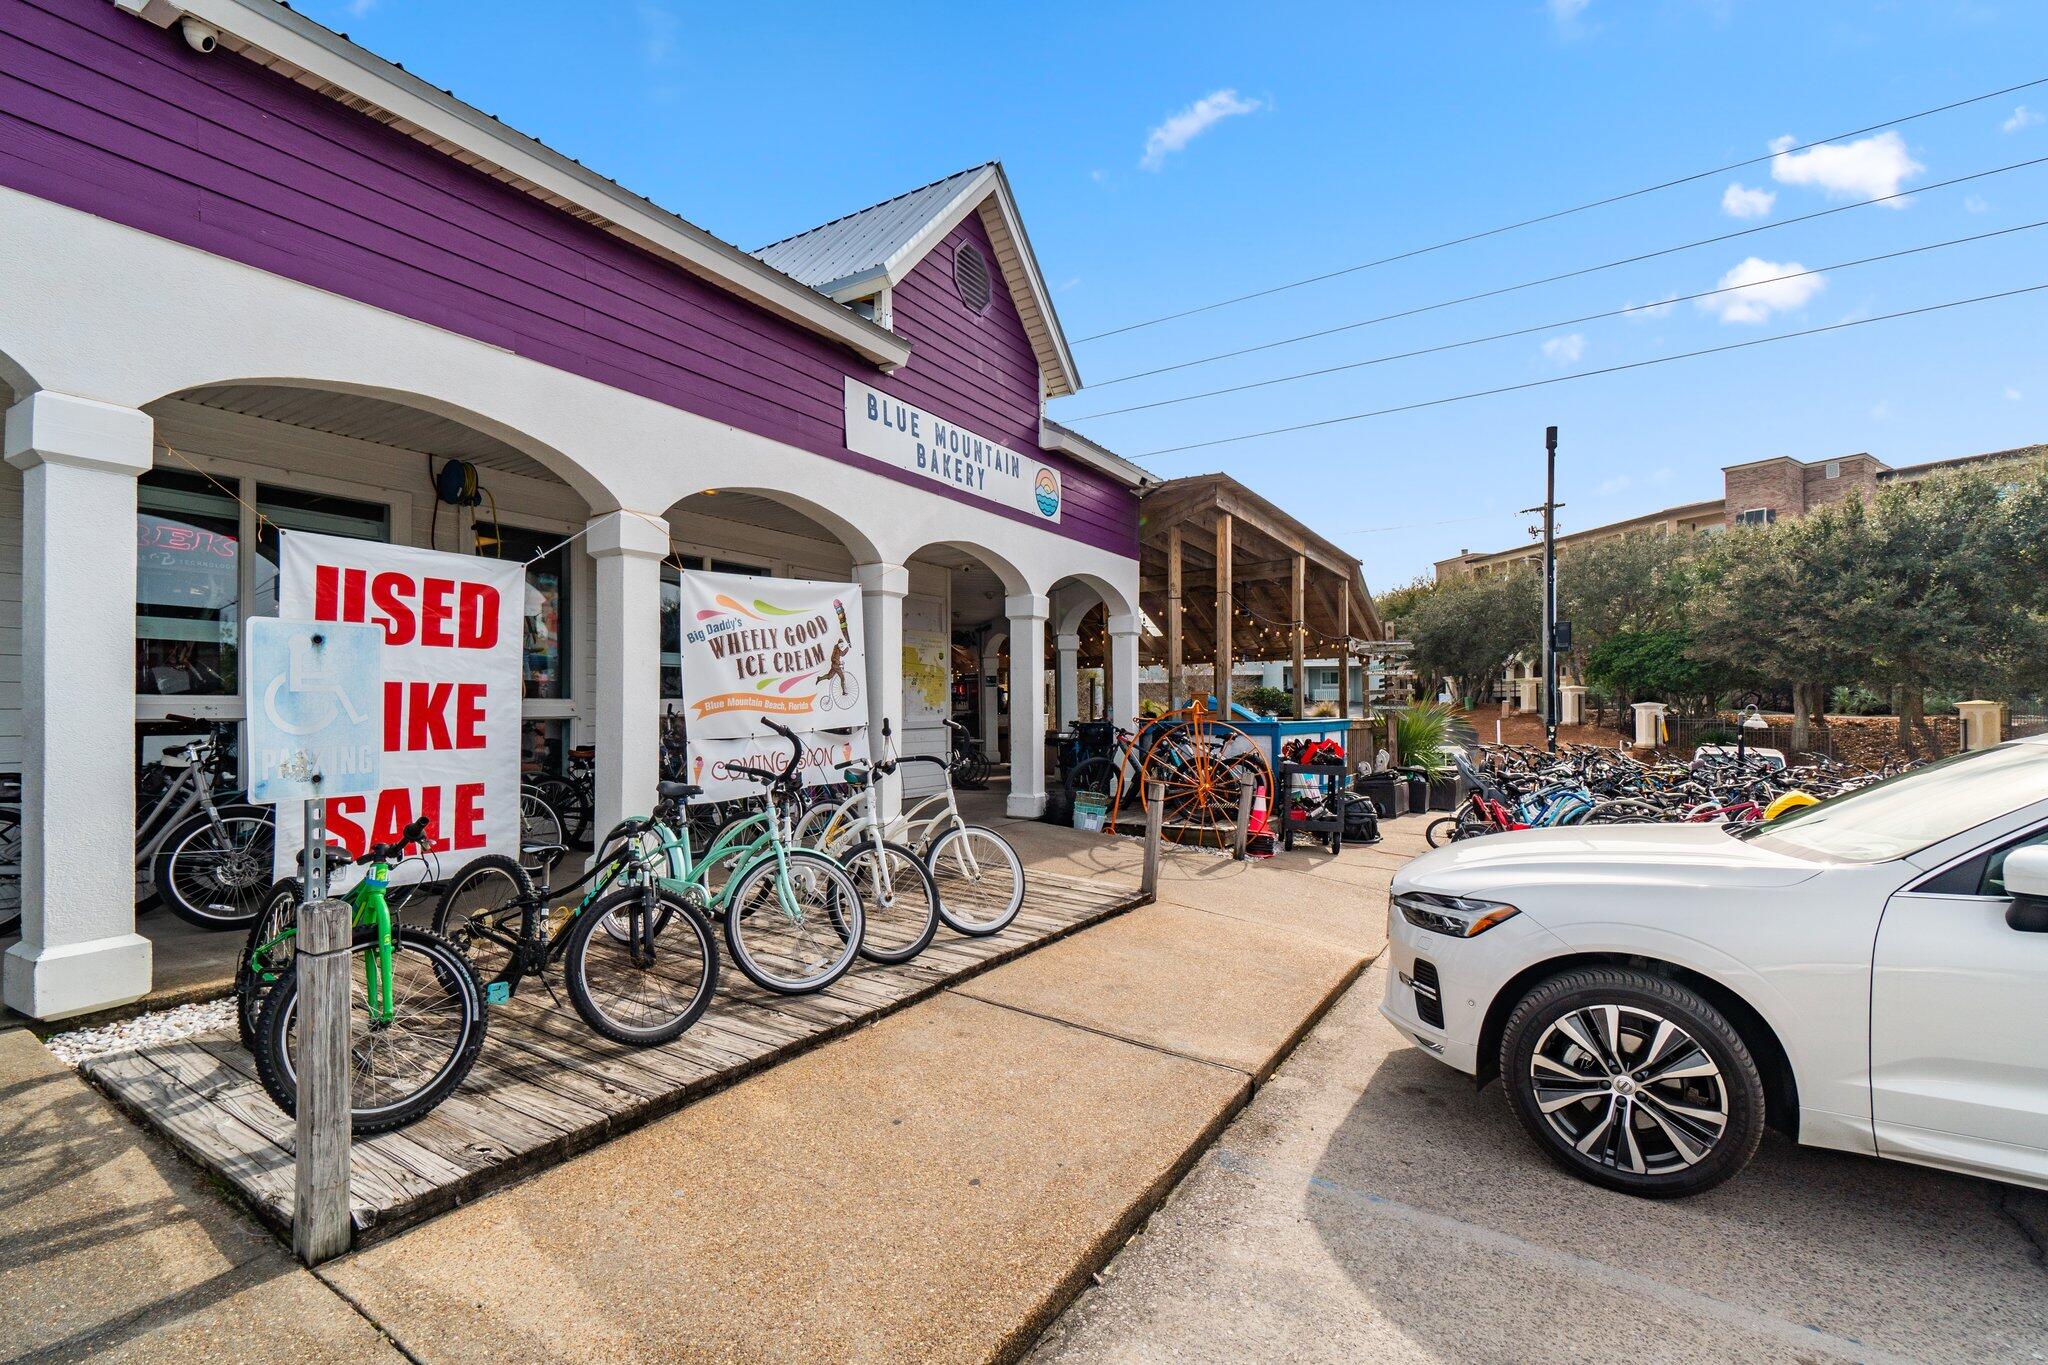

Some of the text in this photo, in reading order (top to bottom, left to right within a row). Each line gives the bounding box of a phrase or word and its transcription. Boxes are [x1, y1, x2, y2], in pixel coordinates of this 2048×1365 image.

[867, 392, 1020, 479] BLUE MOUNTAIN
[916, 443, 985, 491] BAKERY
[314, 564, 501, 650] USED
[686, 617, 743, 644] Big Daddy's
[707, 615, 829, 660] WHEELY GOOD
[735, 643, 826, 680] ICE CREAM
[383, 681, 488, 753] IKE
[704, 697, 809, 711] Blue Mountain Beach, Florida
[711, 750, 789, 781] COMING
[325, 783, 487, 862] SALE
